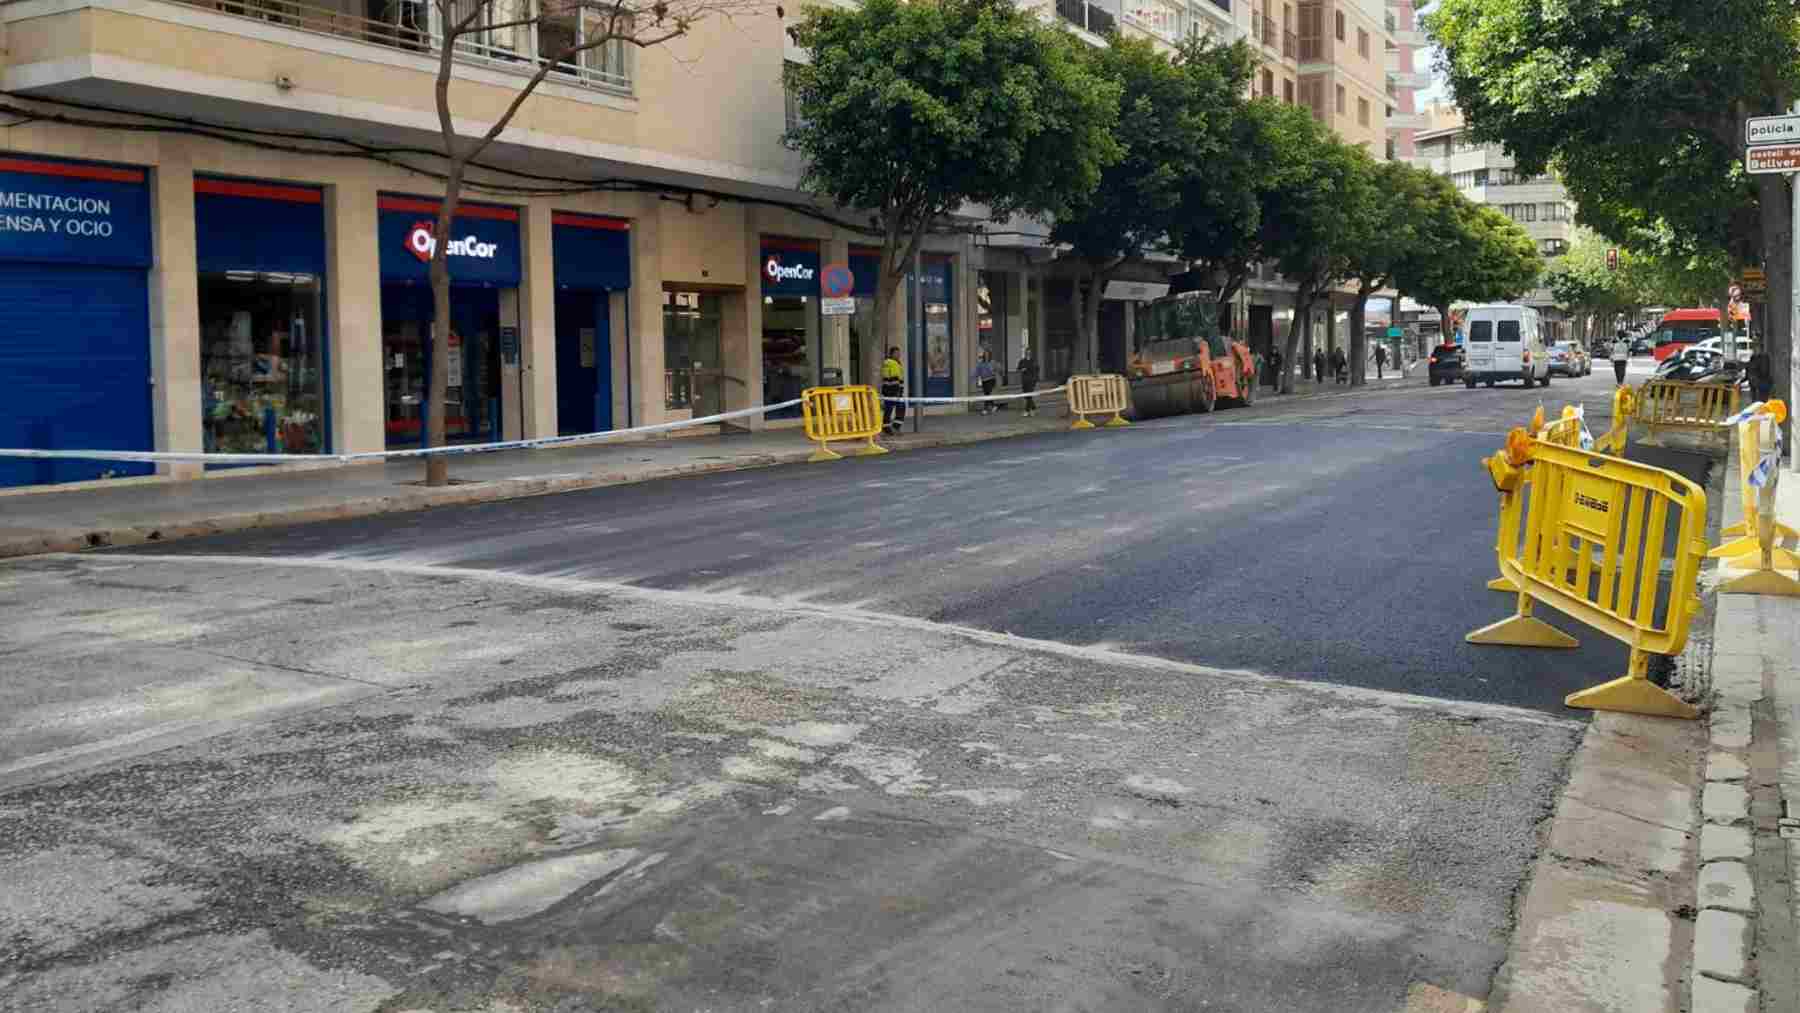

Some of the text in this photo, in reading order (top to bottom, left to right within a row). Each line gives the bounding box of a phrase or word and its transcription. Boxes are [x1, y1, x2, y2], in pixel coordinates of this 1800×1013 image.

[48, 217, 62, 233] Y
[66, 219, 113, 237] OCIO
[767, 259, 814, 282] OpenCor
